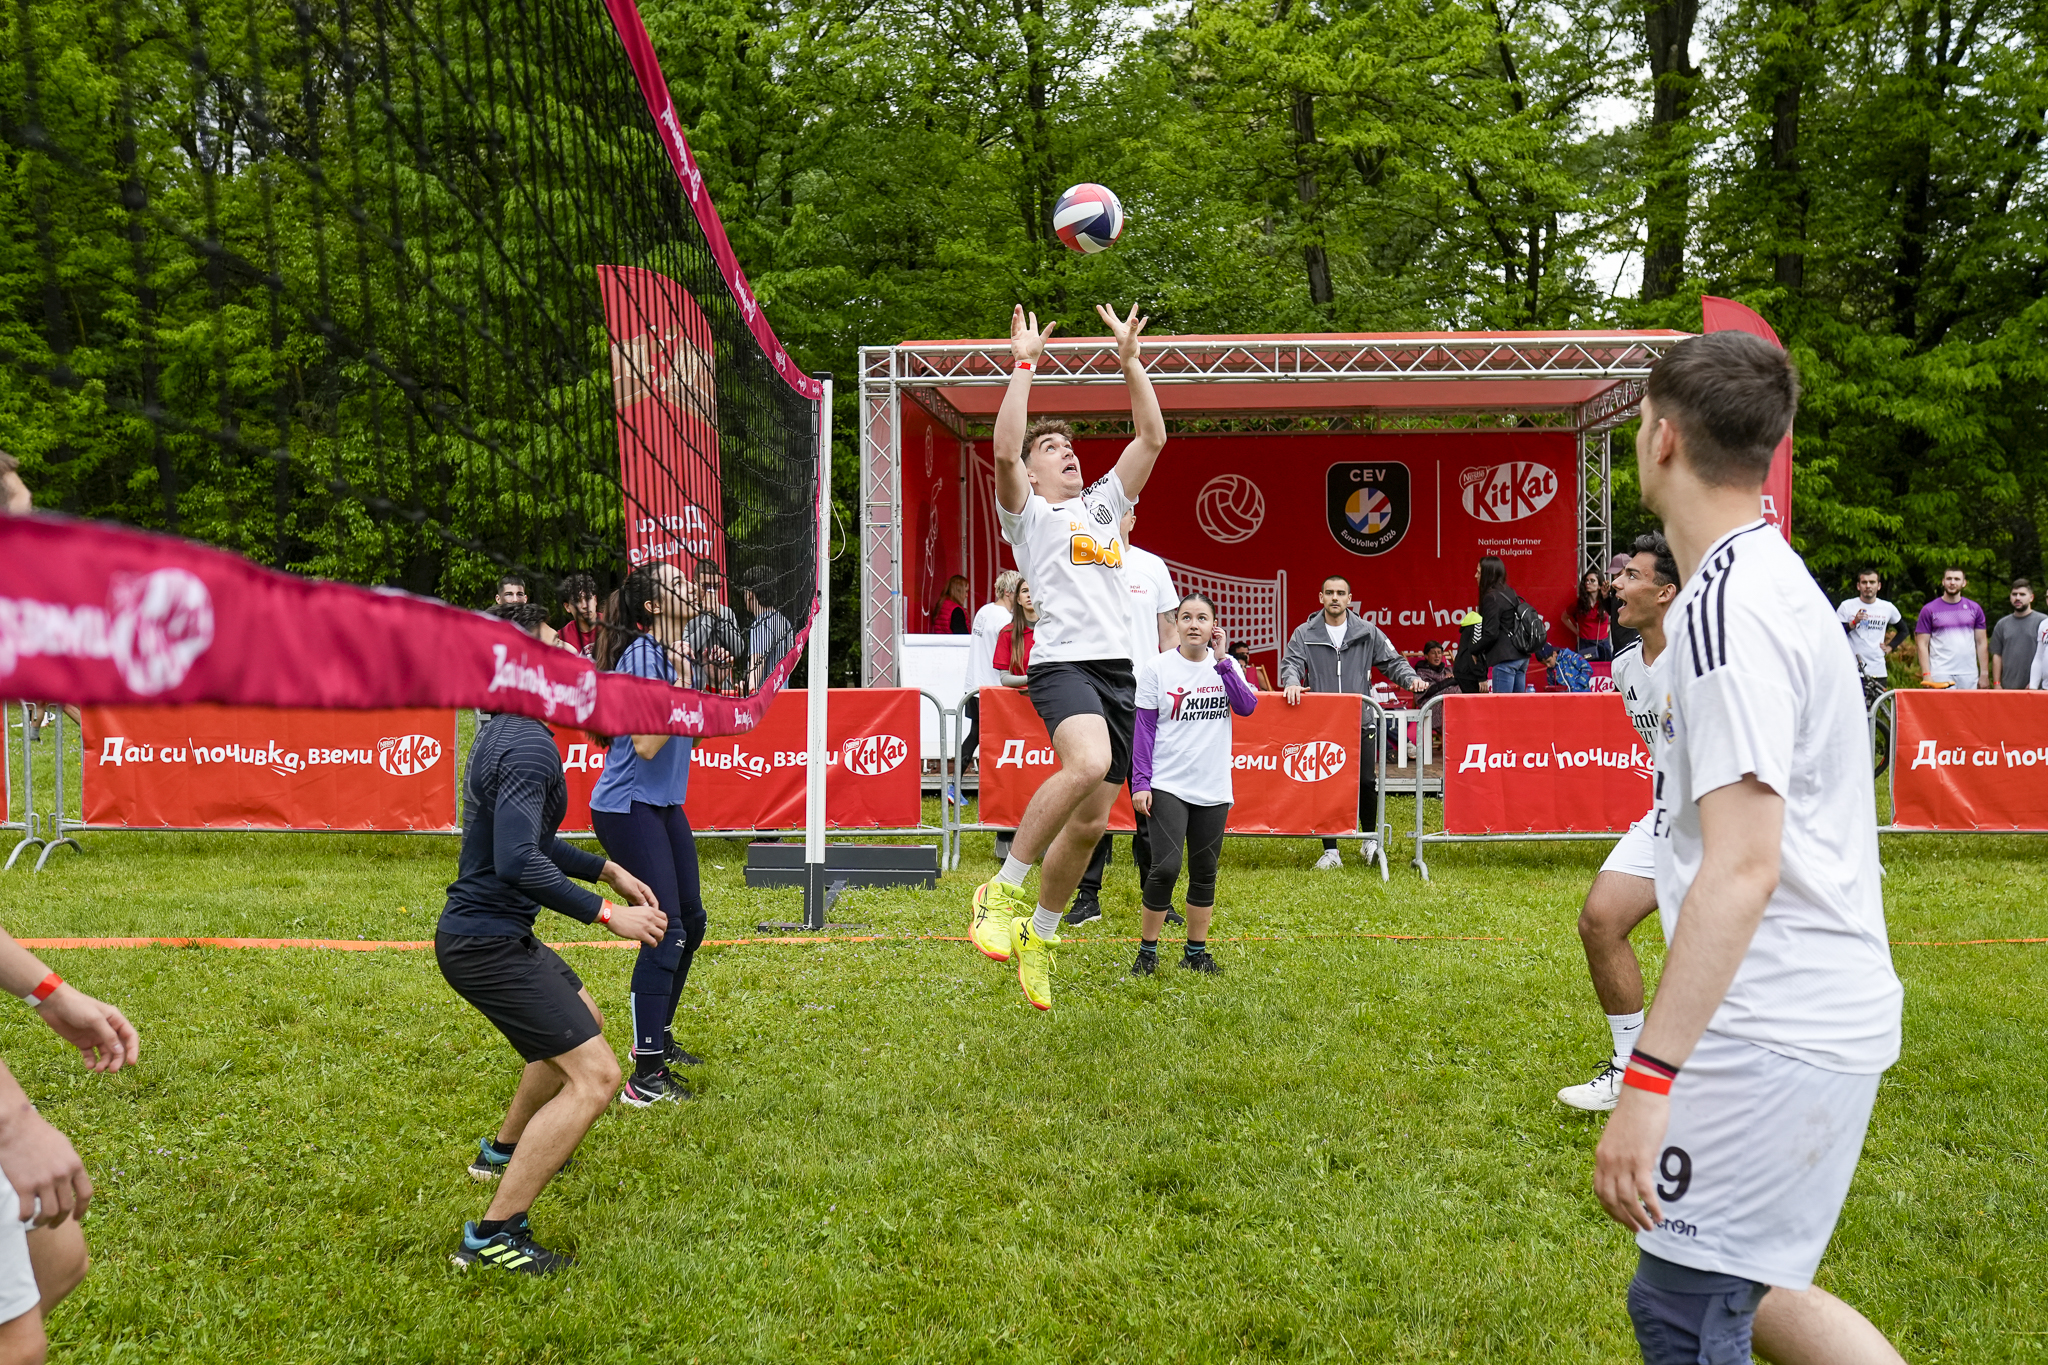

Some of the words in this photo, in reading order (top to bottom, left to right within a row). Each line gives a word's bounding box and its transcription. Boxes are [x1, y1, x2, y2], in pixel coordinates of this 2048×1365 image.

[1350, 469, 1386, 482] CEV
[1472, 462, 1554, 521] KitKat
[1341, 529, 1379, 548] EuroVolley
[1379, 529, 1397, 545] 2026
[1500, 548, 1533, 557] Bulgaria
[1399, 610, 1425, 627] си
[99, 737, 153, 766] Дай
[160, 747, 186, 763] си
[308, 748, 373, 764] вземи
[385, 736, 439, 775] KitKat
[563, 744, 606, 772] Да
[774, 751, 838, 767] взеи
[852, 736, 905, 775] KitKat
[995, 739, 1055, 769] Дай
[1290, 742, 1344, 781] KitKat
[1458, 743, 1516, 773] Дай
[1523, 752, 1549, 768] си
[1911, 740, 1966, 770] Дай
[1972, 750, 1998, 766] си
[1657, 1146, 1692, 1203] 9
